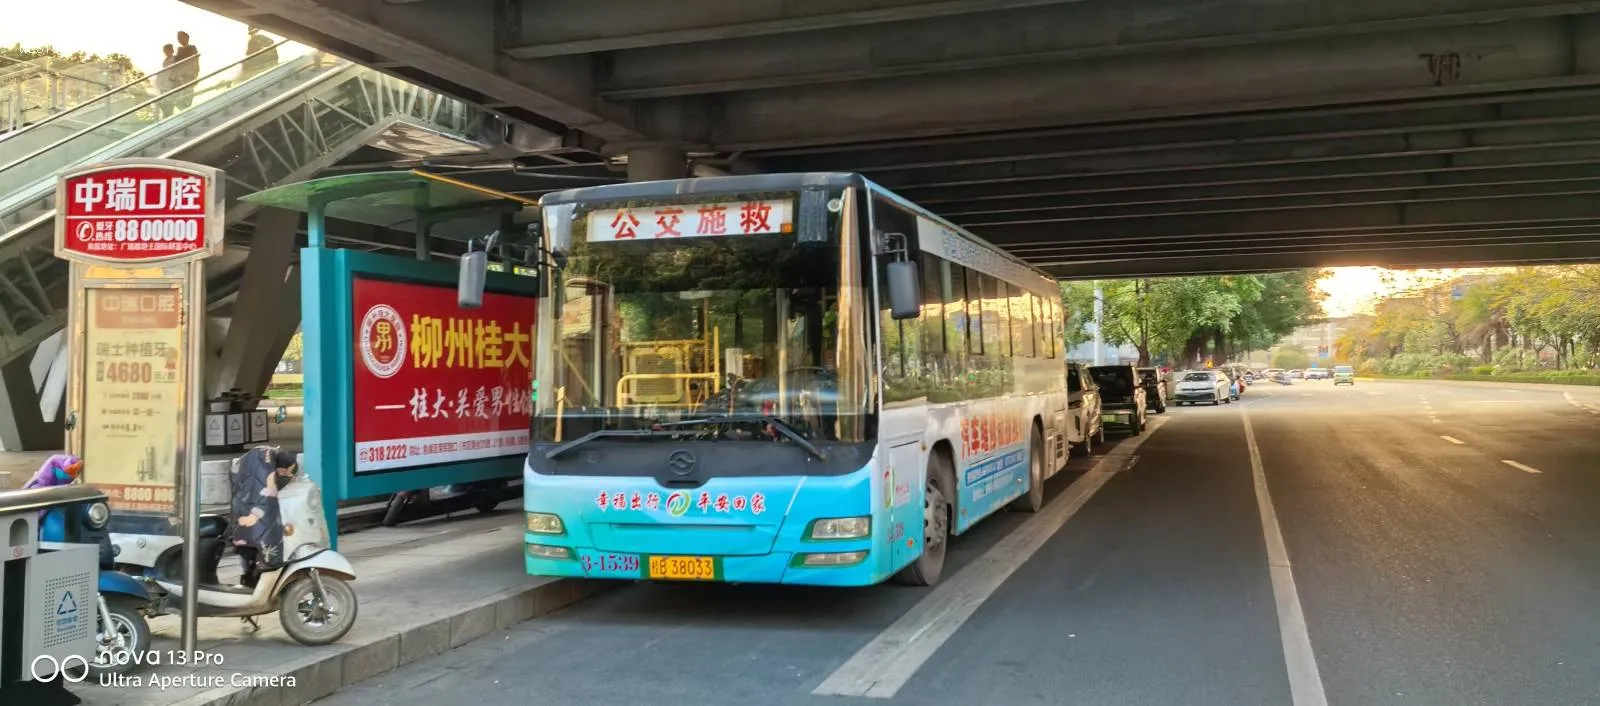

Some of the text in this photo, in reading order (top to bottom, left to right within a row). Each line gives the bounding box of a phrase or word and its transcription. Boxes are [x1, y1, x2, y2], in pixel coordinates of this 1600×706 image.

[75, 176, 202, 212] 中瑞口腔
[611, 200, 773, 240] 公交施救
[102, 294, 175, 312] 中瑞口腔
[410, 313, 535, 369] 柳州桂大
[106, 362, 153, 384] 4680
[369, 446, 385, 463] 318
[385, 444, 408, 461] 2222
[594, 490, 768, 514] 幸福出行 平安回家
[580, 554, 640, 573] 3-1539
[671, 557, 713, 577] 38033
